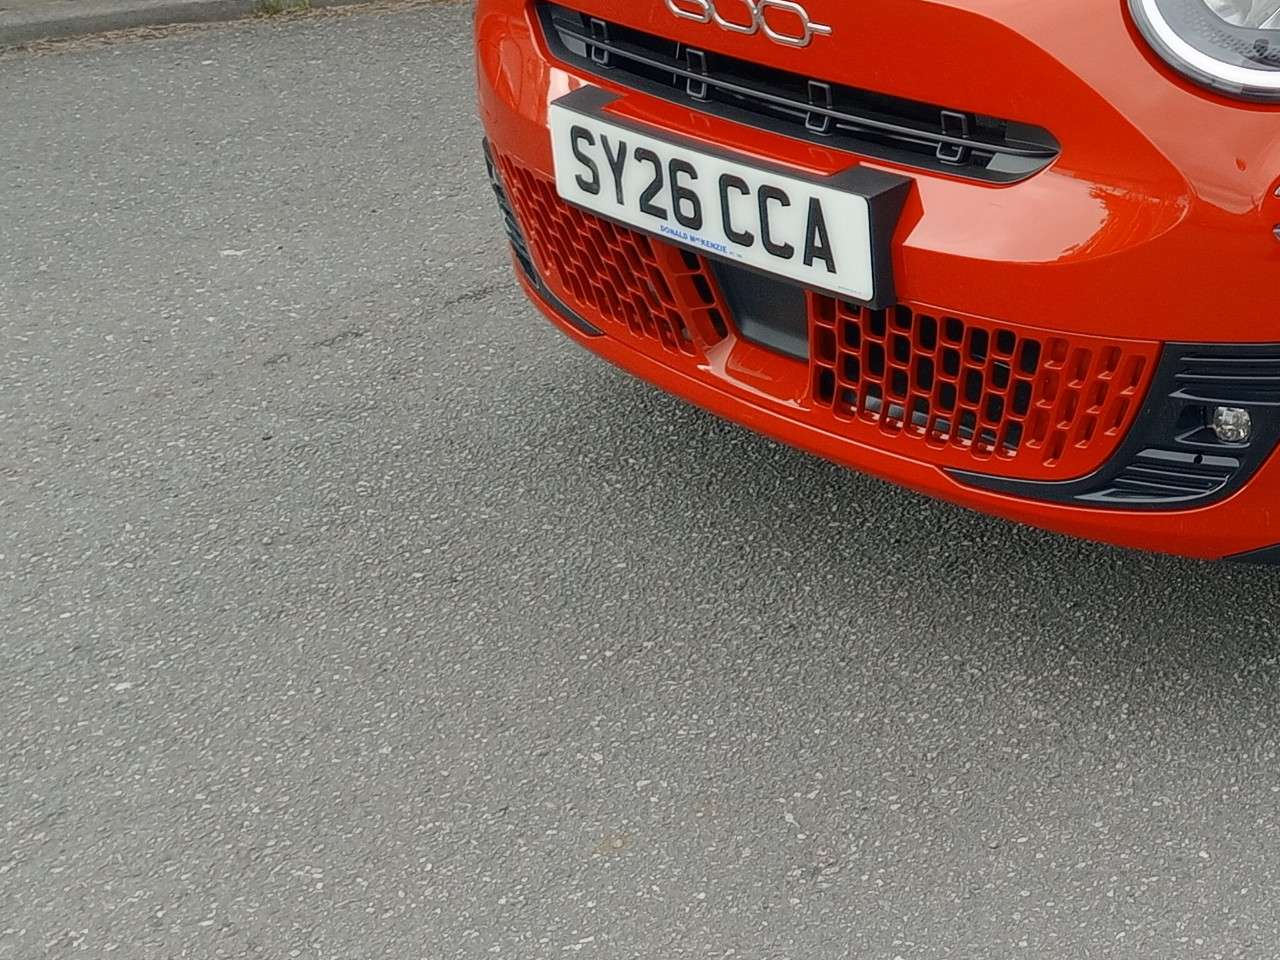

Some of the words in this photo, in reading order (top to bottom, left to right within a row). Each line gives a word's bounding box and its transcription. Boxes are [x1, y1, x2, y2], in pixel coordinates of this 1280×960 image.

[570, 124, 703, 231] SY26
[718, 173, 837, 274] CCA
[660, 224, 689, 241] DONALD
